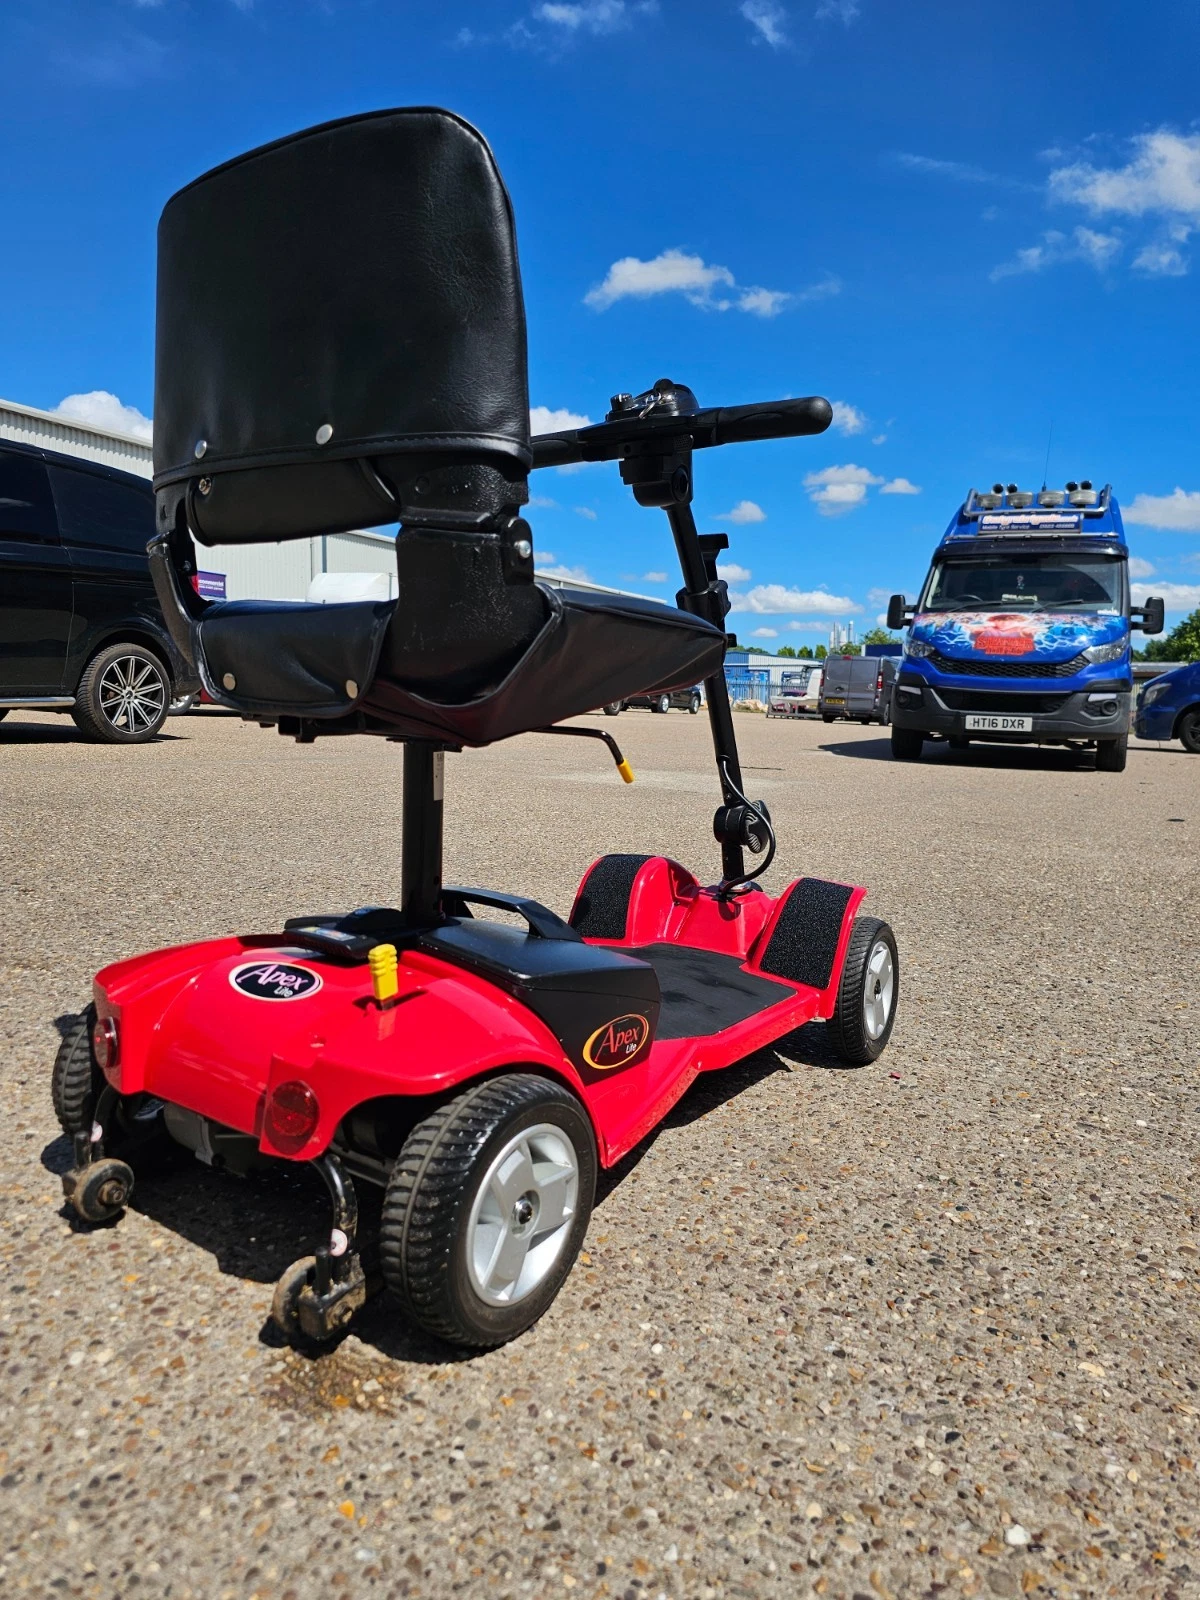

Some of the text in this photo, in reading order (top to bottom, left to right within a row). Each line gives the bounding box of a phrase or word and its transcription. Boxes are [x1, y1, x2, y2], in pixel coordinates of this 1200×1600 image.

[972, 717, 1025, 729] HT16 DXR
[236, 964, 309, 991] Apex
[273, 985, 294, 998] Lite
[594, 1023, 640, 1062] Apex
[625, 1042, 637, 1055] Lite
